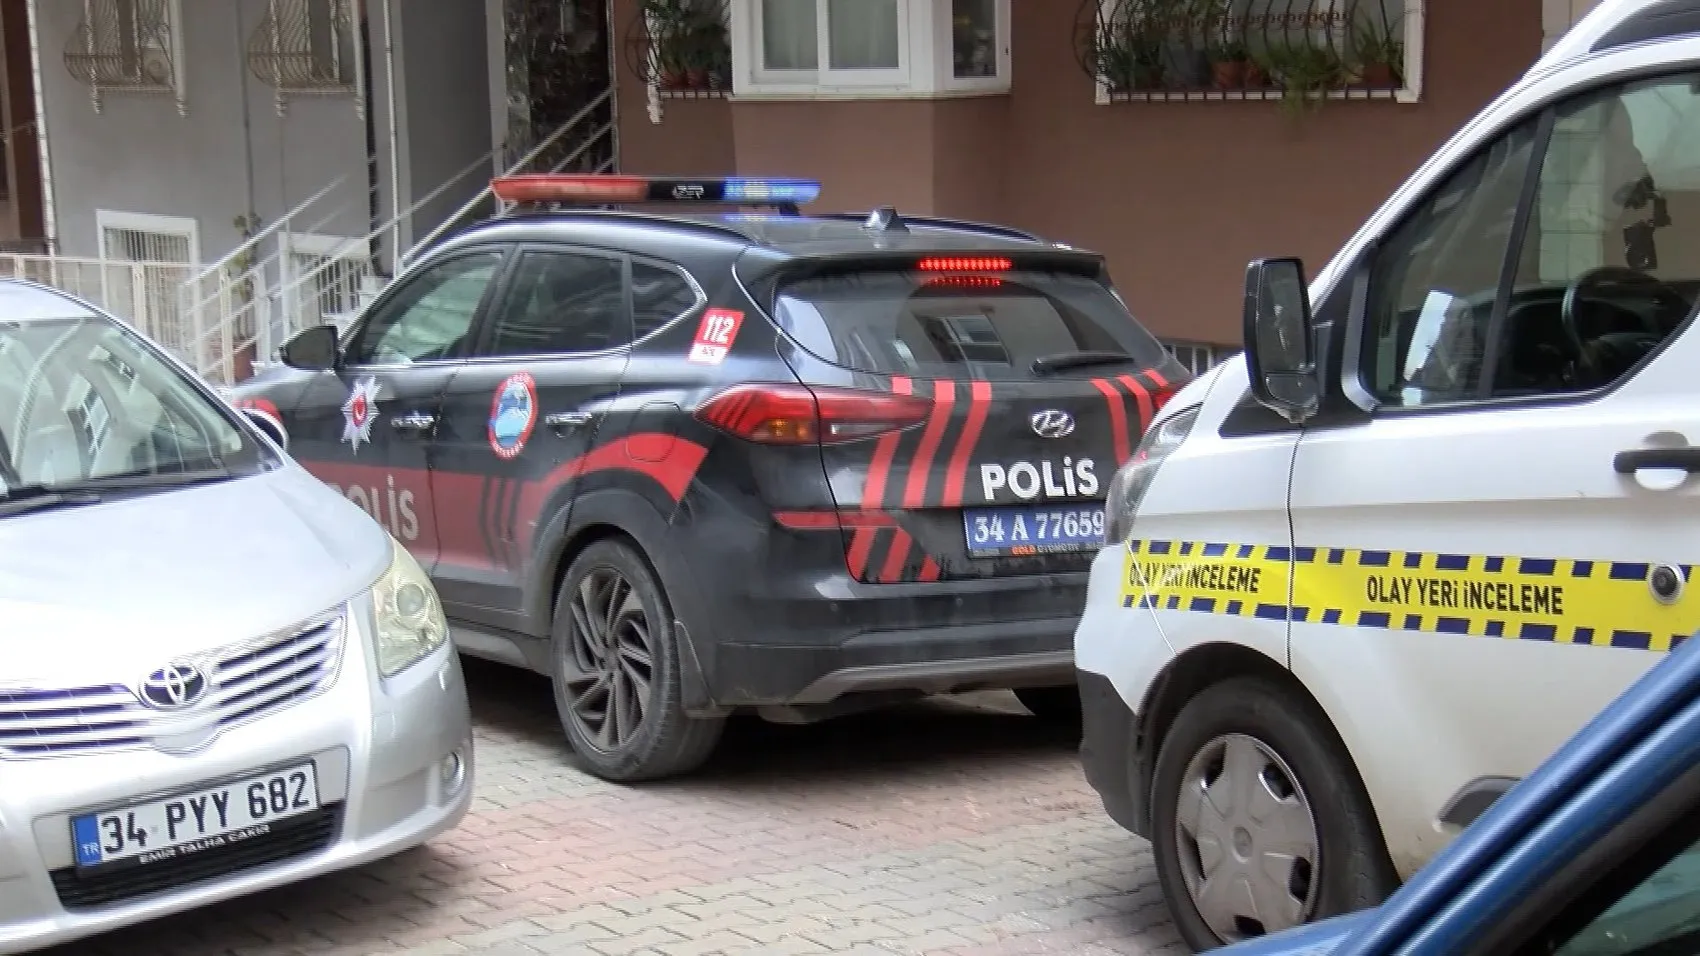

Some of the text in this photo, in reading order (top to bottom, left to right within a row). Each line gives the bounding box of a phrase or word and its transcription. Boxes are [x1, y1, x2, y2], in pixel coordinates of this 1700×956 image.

[703, 314, 735, 344] 112
[974, 510, 1104, 543] 34 A 77659
[1129, 562, 1160, 587] OLAY
[1367, 575, 1412, 604] OLAY
[101, 771, 309, 854] 34 PYY 682
[81, 842, 100, 856] TR
